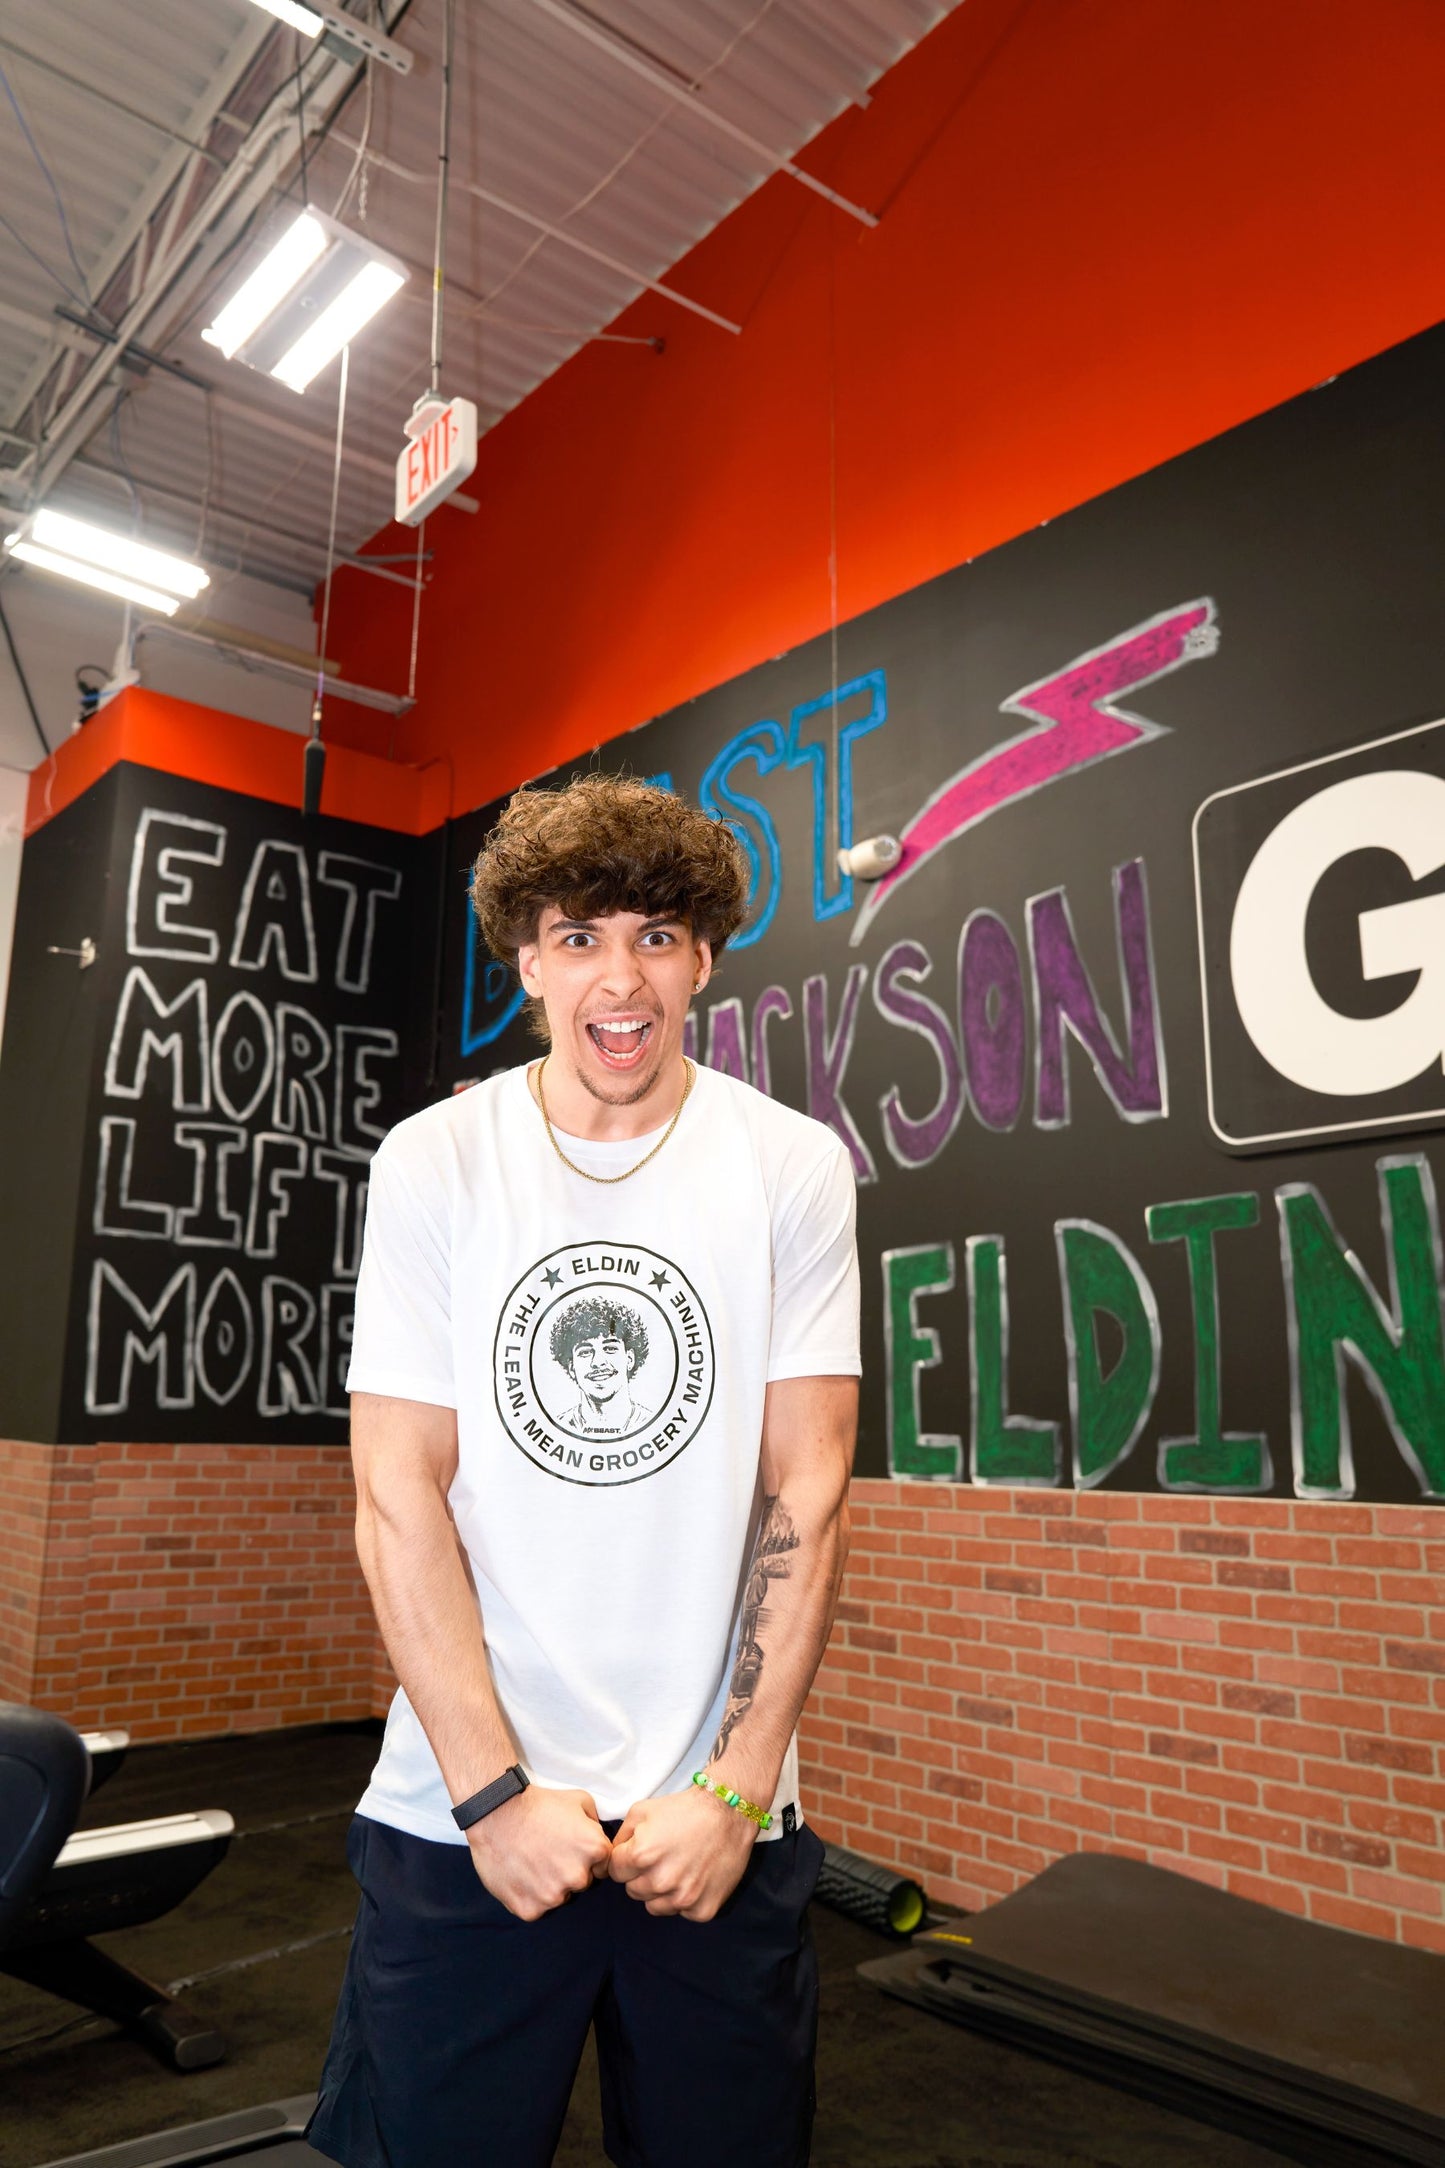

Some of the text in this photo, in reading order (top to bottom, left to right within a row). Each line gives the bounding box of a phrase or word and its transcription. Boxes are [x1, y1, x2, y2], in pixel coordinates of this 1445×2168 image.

[407, 407, 453, 506] EXIT
[127, 807, 402, 994] EAT
[104, 965, 399, 1158] MORE
[681, 856, 1169, 1189] ACKSON
[93, 1116, 371, 1279] LIFT
[572, 1255, 641, 1276] ELDIN
[504, 1290, 704, 1472] THE LEAN, MEAN GROCERY MACHINE
[881, 1152, 1445, 1500] ELDIN
